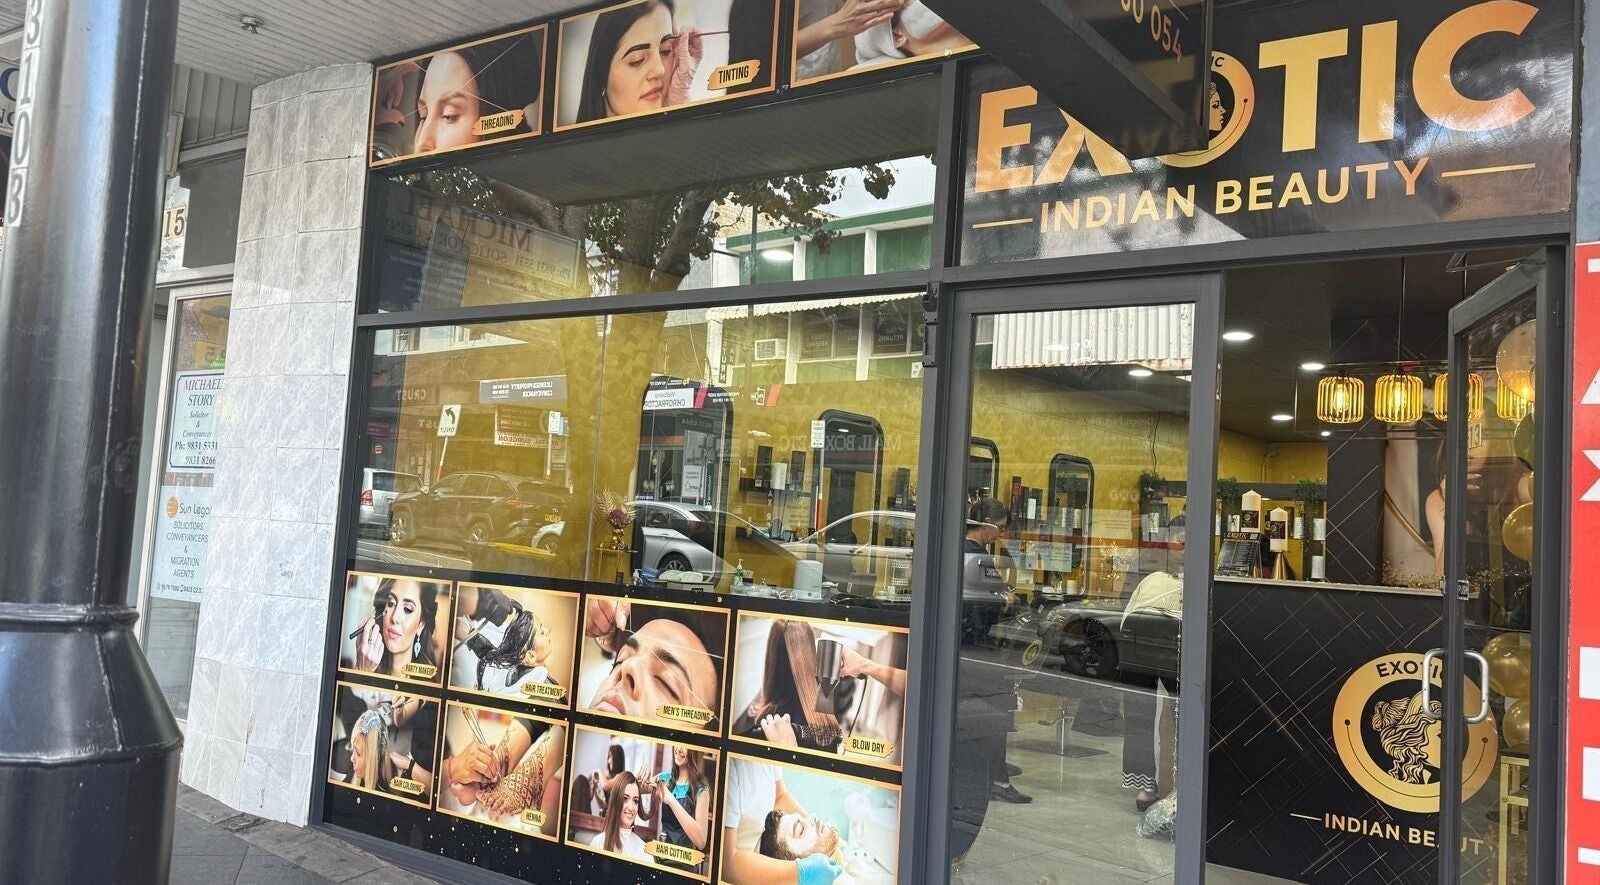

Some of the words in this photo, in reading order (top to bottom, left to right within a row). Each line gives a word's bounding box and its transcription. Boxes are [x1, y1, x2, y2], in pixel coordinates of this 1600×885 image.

[1150, 4, 1182, 63] 054
[718, 65, 749, 84] TINTING
[480, 113, 514, 131] THREADING
[1040, 184, 1195, 233] INDIAN
[1215, 157, 1430, 214] BEAUTY
[164, 208, 185, 238] 15
[184, 378, 222, 391] MICHAEL
[188, 394, 215, 406] STORY
[179, 502, 192, 514] Sun
[173, 520, 204, 531] SOLICITORS
[166, 532, 209, 543] CONVEYANCERS
[170, 556, 200, 567] MIGRATION
[172, 569, 195, 579] AGENTS
[405, 663, 418, 673] PARTY
[418, 665, 435, 676] MAKEUP
[1375, 660, 1443, 679] EXOI
[525, 683, 537, 694] HAIR
[537, 685, 563, 697] TREATMENT
[663, 705, 679, 717] MEN'S
[680, 707, 711, 722] THREADING
[852, 739, 870, 753] BLOW
[871, 742, 885, 754] DRY
[393, 778, 403, 788] HAIR
[403, 780, 423, 793] COLORING
[526, 810, 543, 824] HENNA
[1324, 812, 1400, 841] INDIAN
[656, 842, 669, 855] HAIR
[669, 845, 693, 862] CUTTING
